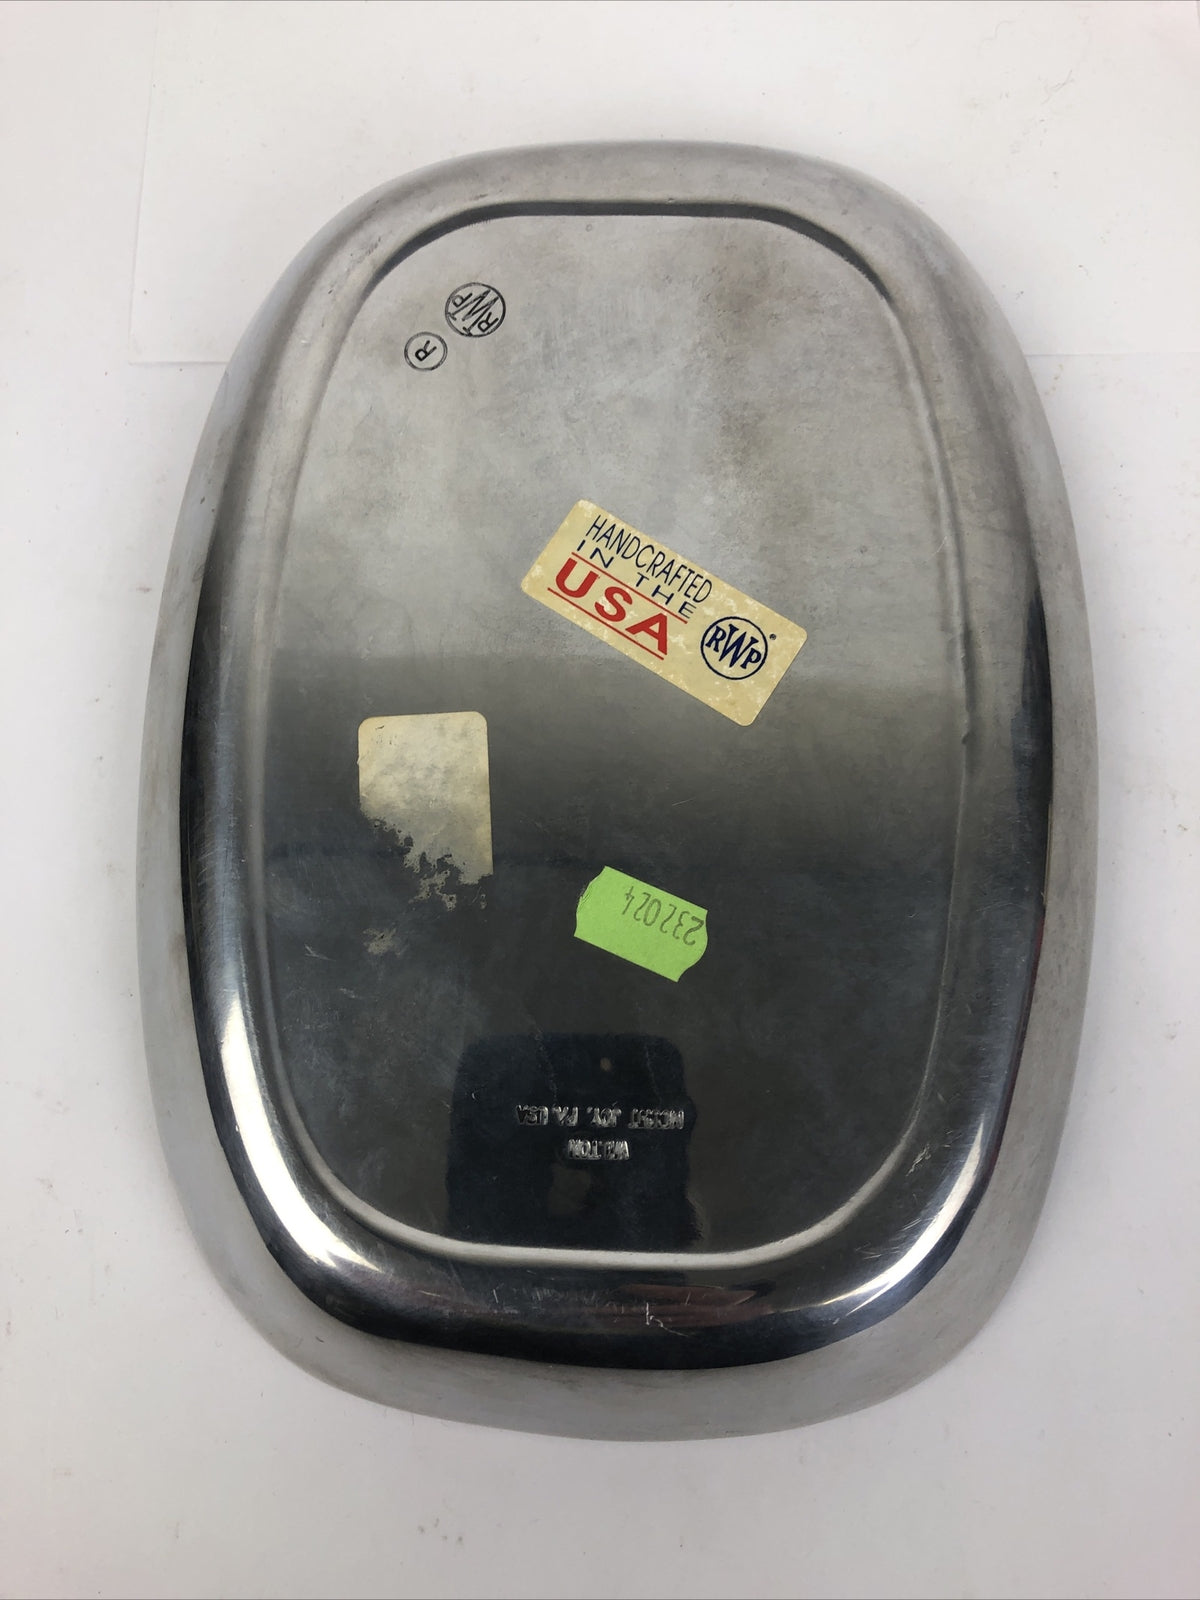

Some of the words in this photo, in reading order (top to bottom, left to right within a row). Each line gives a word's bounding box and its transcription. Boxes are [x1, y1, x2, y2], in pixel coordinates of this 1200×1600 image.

[447, 287, 500, 336] RWP
[577, 540, 614, 569] IN
[635, 573, 698, 619] THE
[585, 514, 712, 603] HANDCRAFTED
[555, 558, 668, 656] USA
[621, 886, 704, 946] 232024
